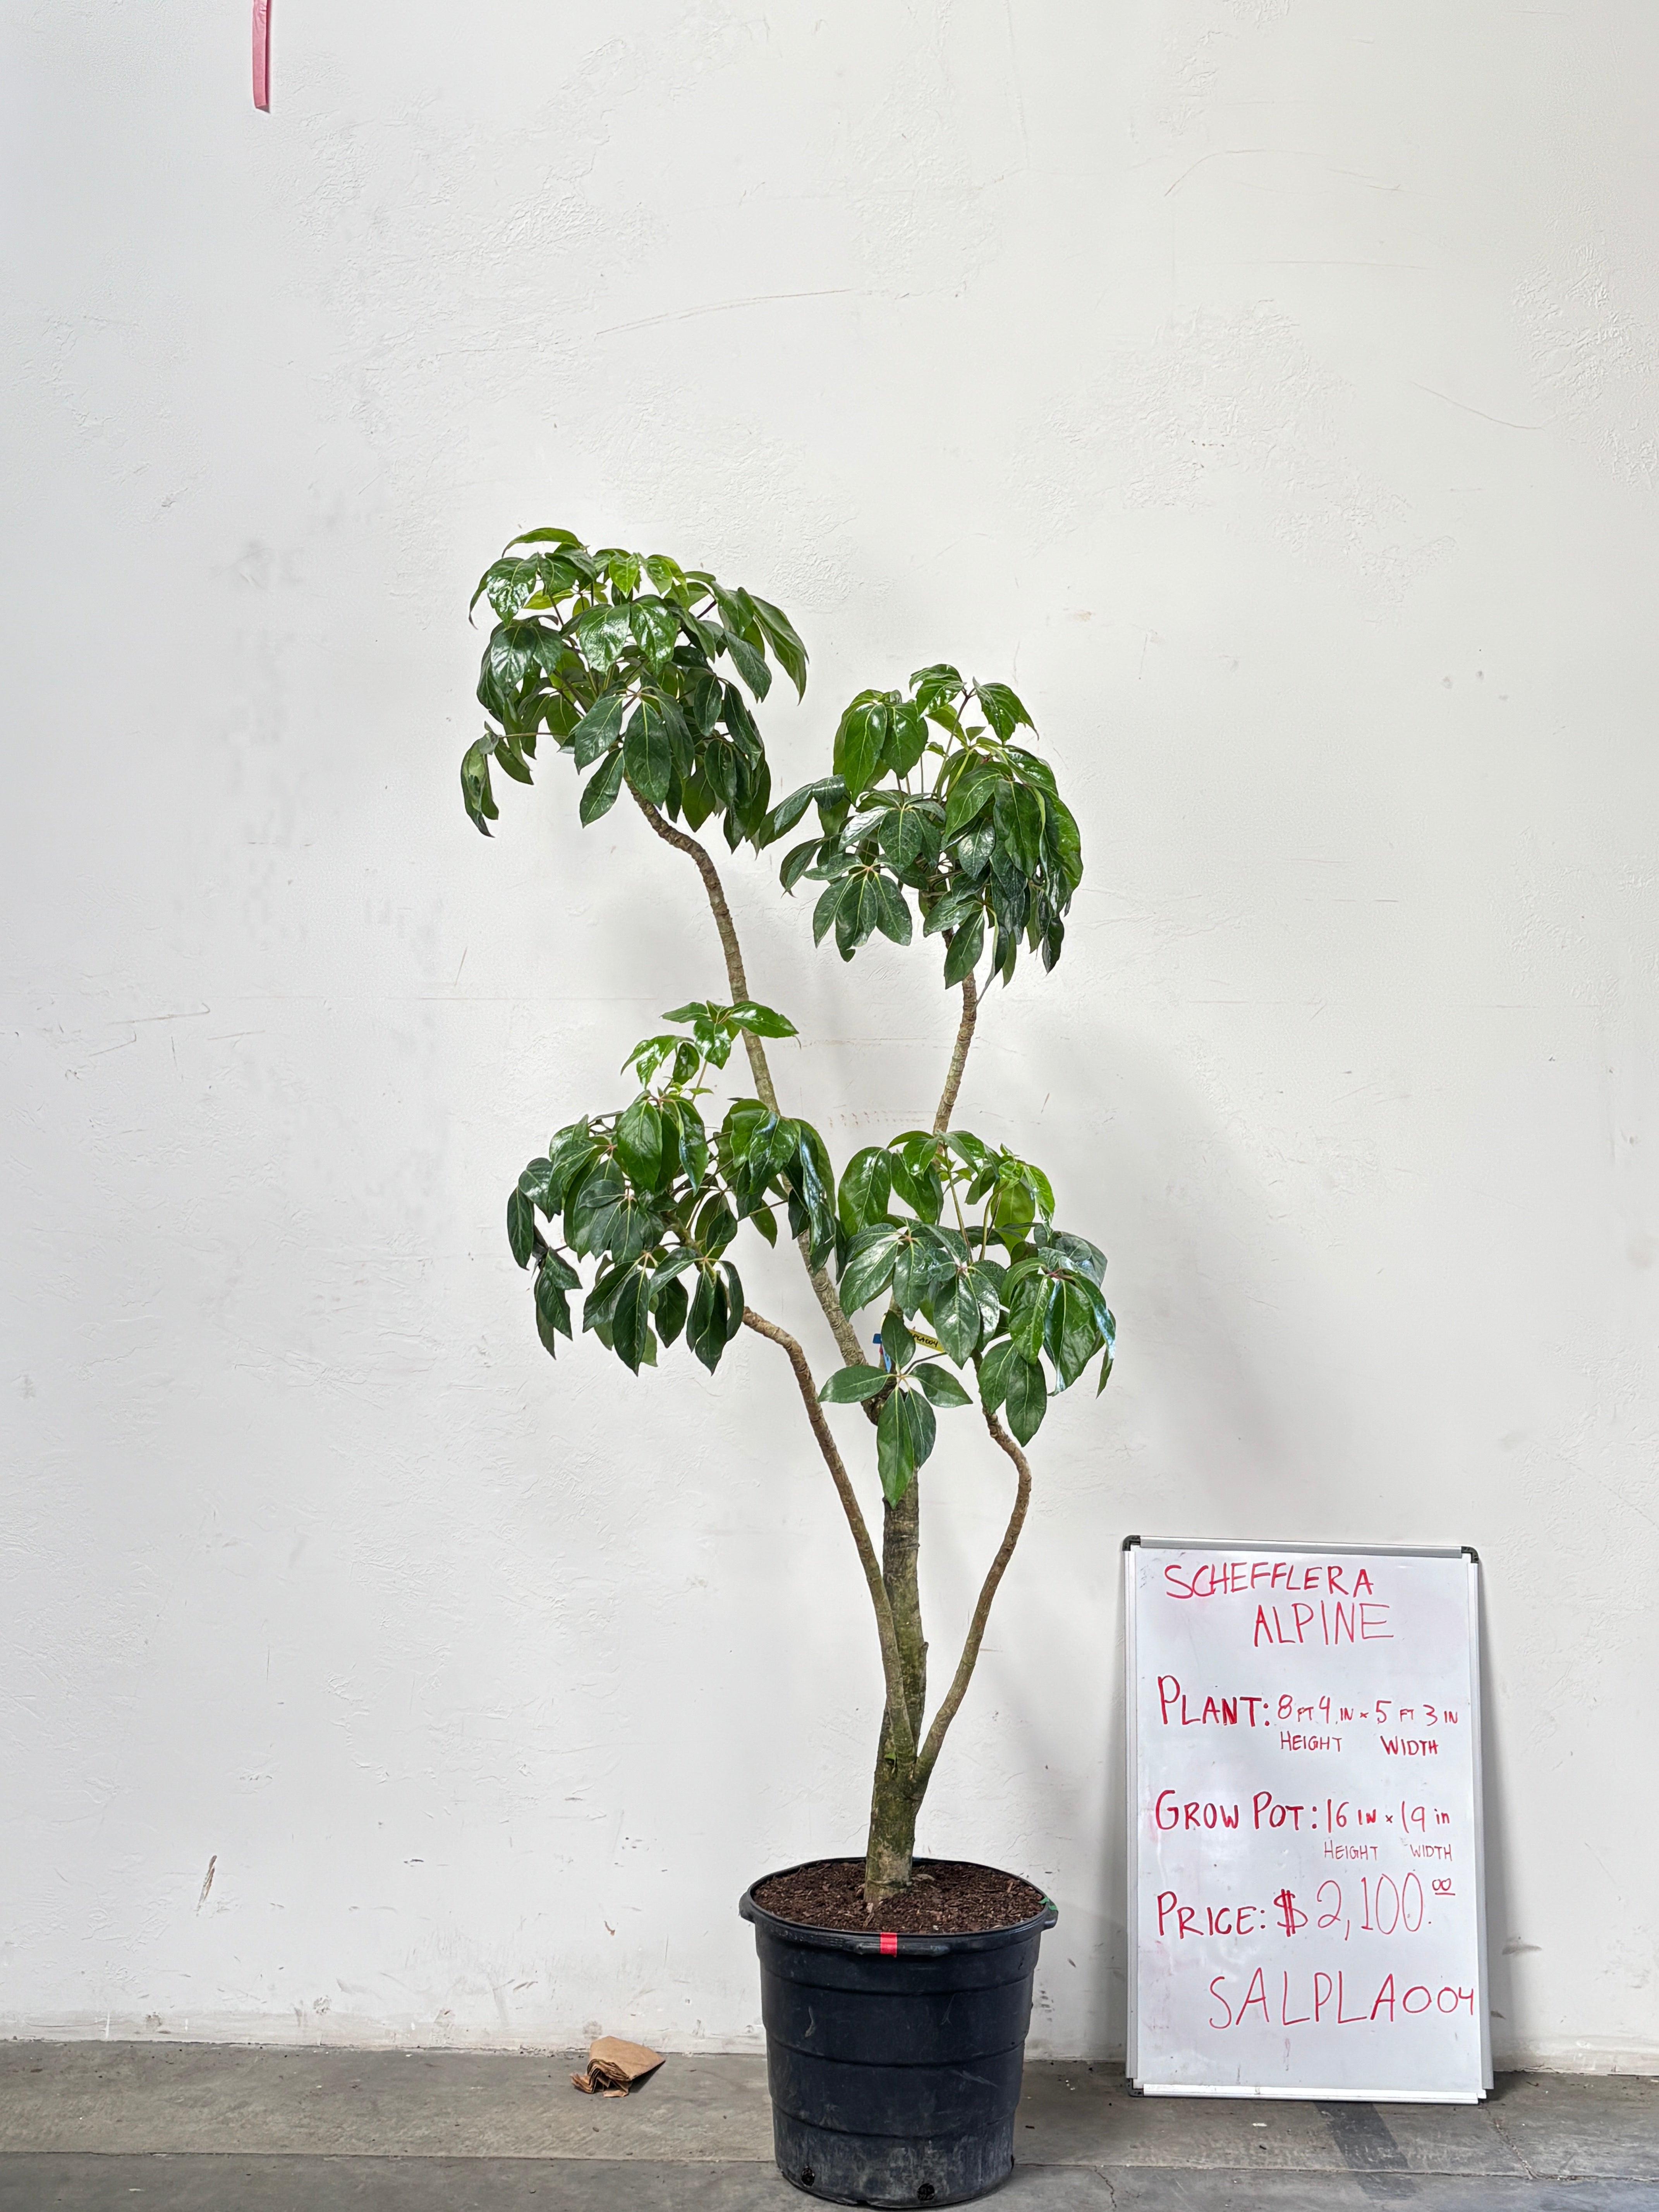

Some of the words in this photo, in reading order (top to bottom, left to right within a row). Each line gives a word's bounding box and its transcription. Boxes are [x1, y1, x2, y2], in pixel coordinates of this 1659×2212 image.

[1164, 1562, 1374, 1599] SCHEFFLERA
[1254, 1600, 1394, 1647] ALPINE
[1157, 1674, 1270, 1728] PLANT:
[1278, 1694, 1293, 1719] 8
[1297, 1706, 1314, 1723] FT
[1375, 1699, 1392, 1724] 5
[1399, 1708, 1415, 1721] FT
[1422, 1704, 1438, 1726] 3
[1443, 1711, 1458, 1724] IN
[1280, 1731, 1343, 1752] HEIGHT
[1380, 1736, 1439, 1757] WIDTH
[1155, 1789, 1239, 1831] GROW
[1252, 1791, 1317, 1831] POT:
[1326, 1798, 1348, 1833] 16
[1400, 1801, 1425, 1833] 19
[1324, 1840, 1379, 1861] HEIGHT
[1410, 1843, 1453, 1861] WIDTH
[1156, 1891, 1266, 1939] PRICE:
[1208, 1967, 1474, 2029] SALPLA004
